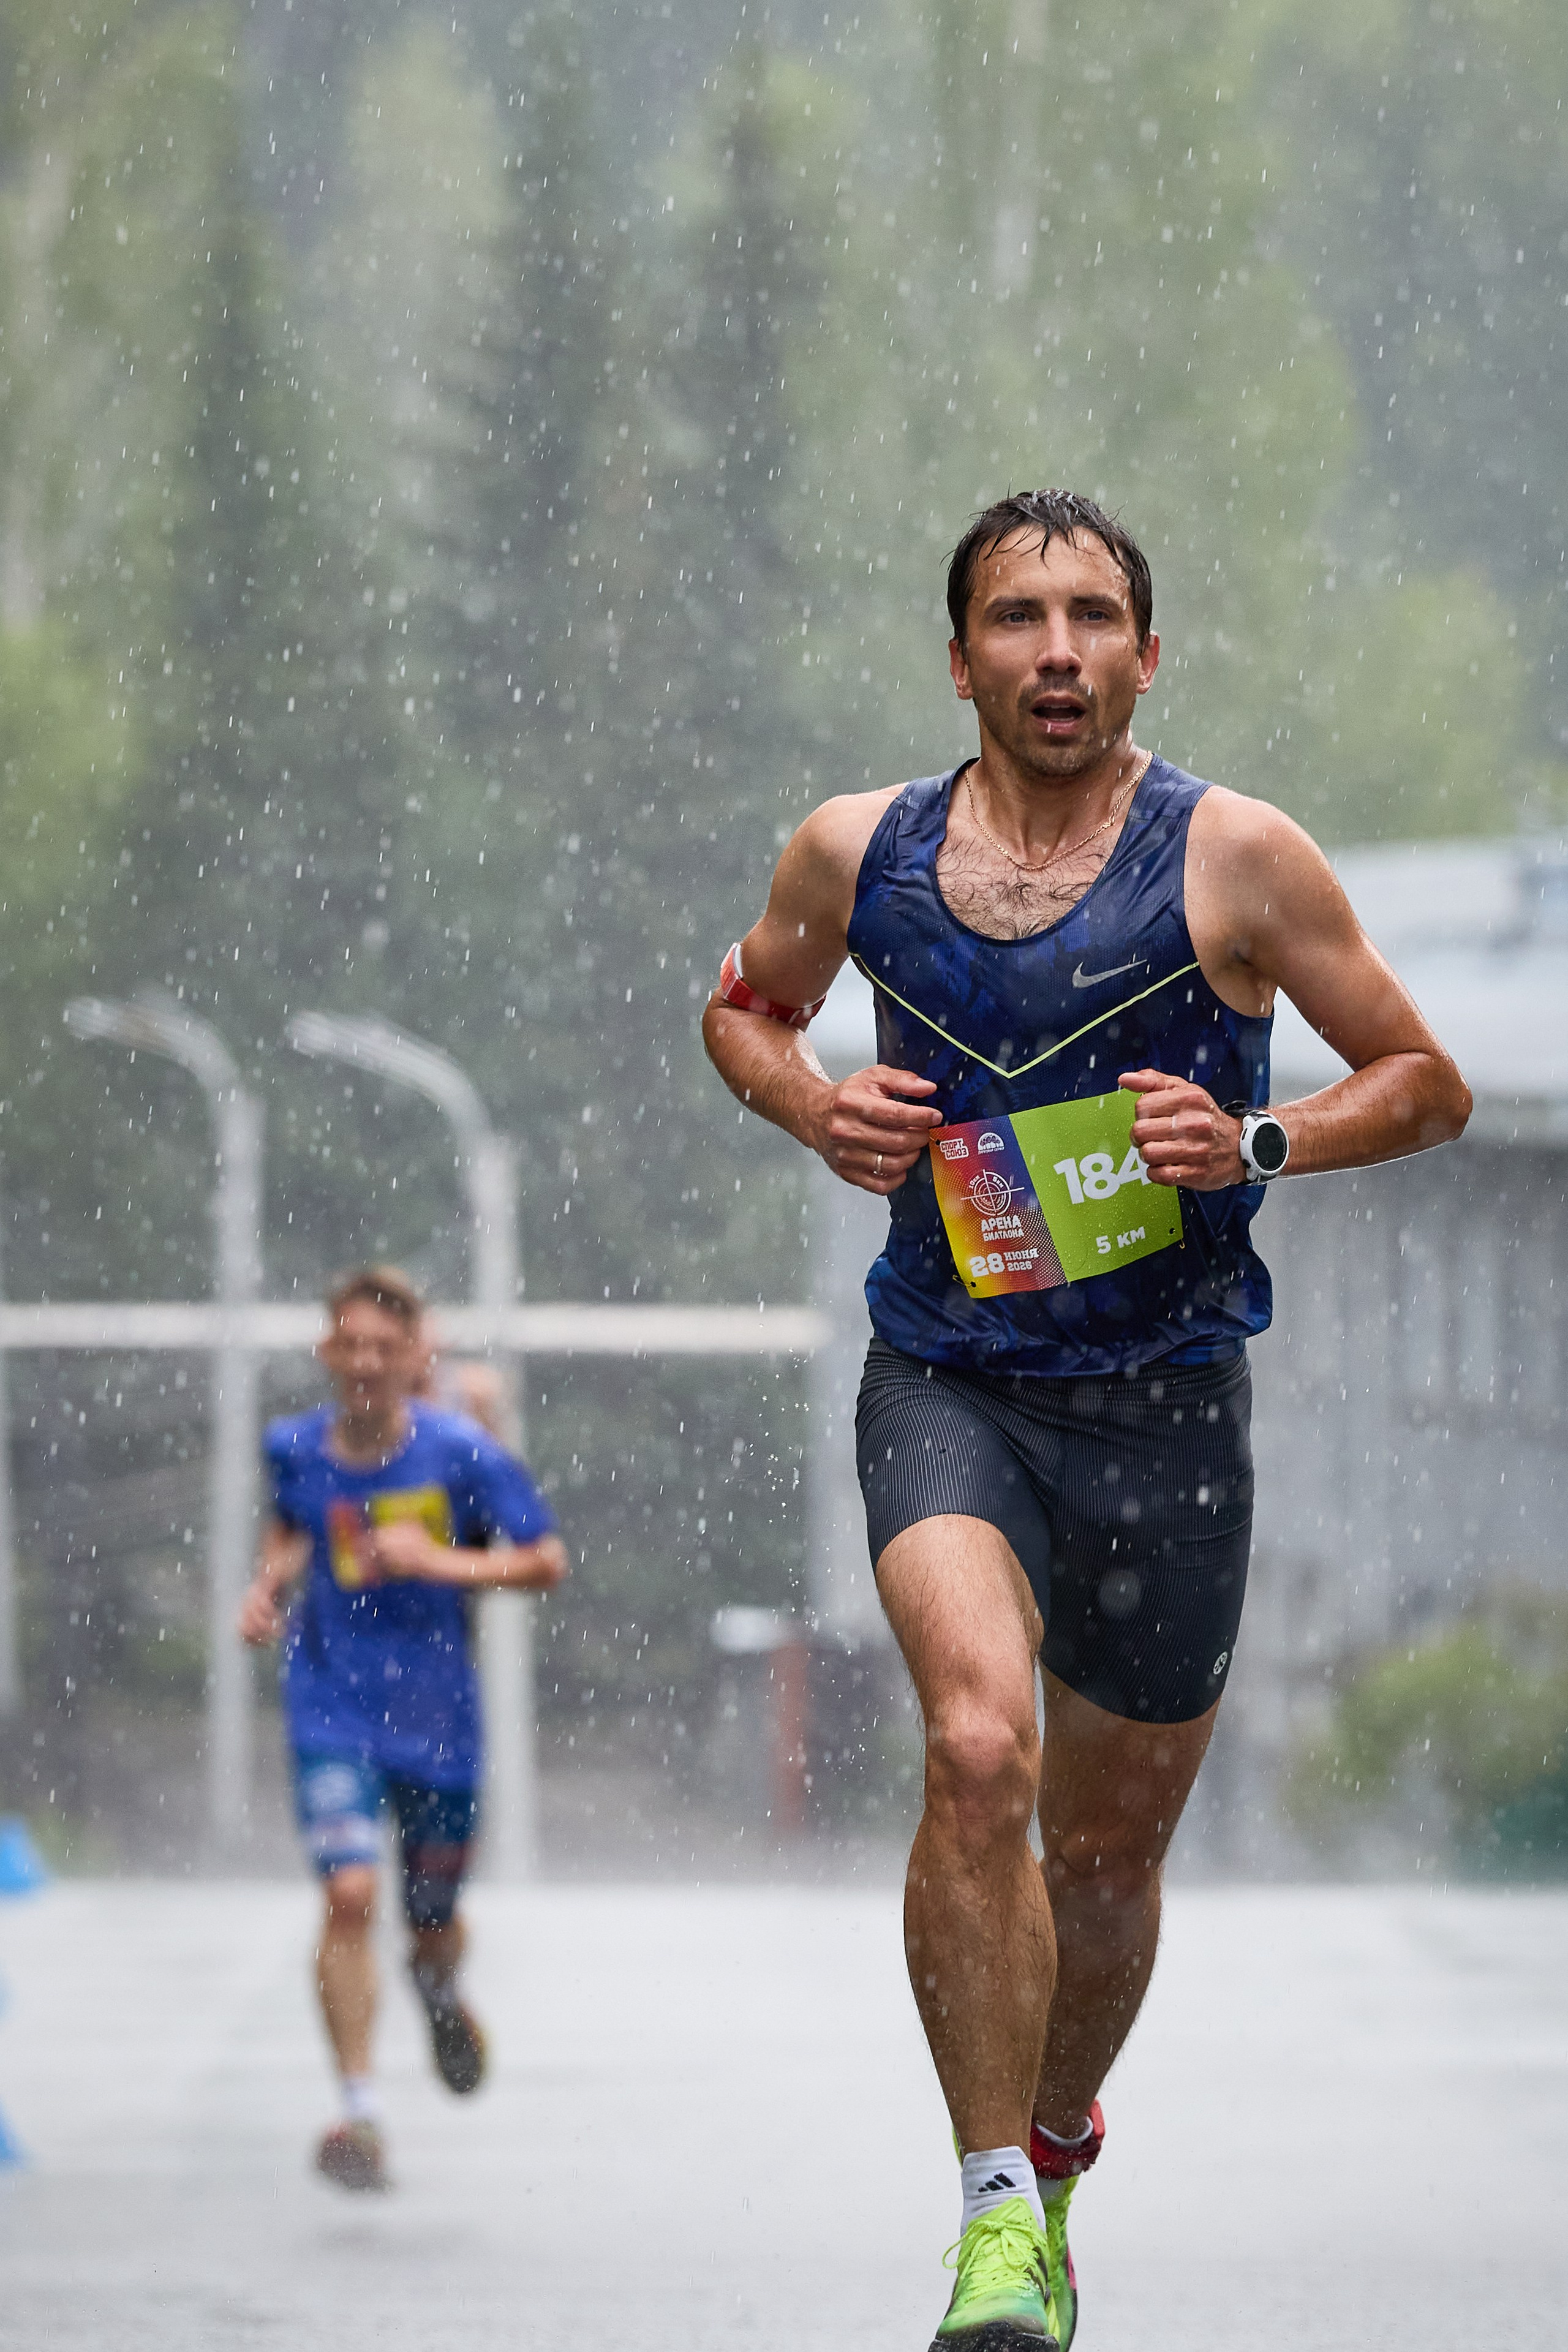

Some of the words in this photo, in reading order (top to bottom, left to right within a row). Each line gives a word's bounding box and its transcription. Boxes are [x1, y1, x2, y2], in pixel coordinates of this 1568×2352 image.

[941, 1140, 962, 1152] СПОРТ
[946, 1148, 967, 1158] СОЮЗ
[1053, 1145, 1152, 1205] 184
[981, 1215, 1022, 1232] АРЕНА
[982, 1227, 1025, 1242] БИАТЛОНА
[1096, 1235, 1112, 1254] 5
[969, 1253, 1005, 1278] 28
[1003, 1248, 1039, 1261] ИЮНЯ
[1007, 1261, 1033, 1272] 2026
